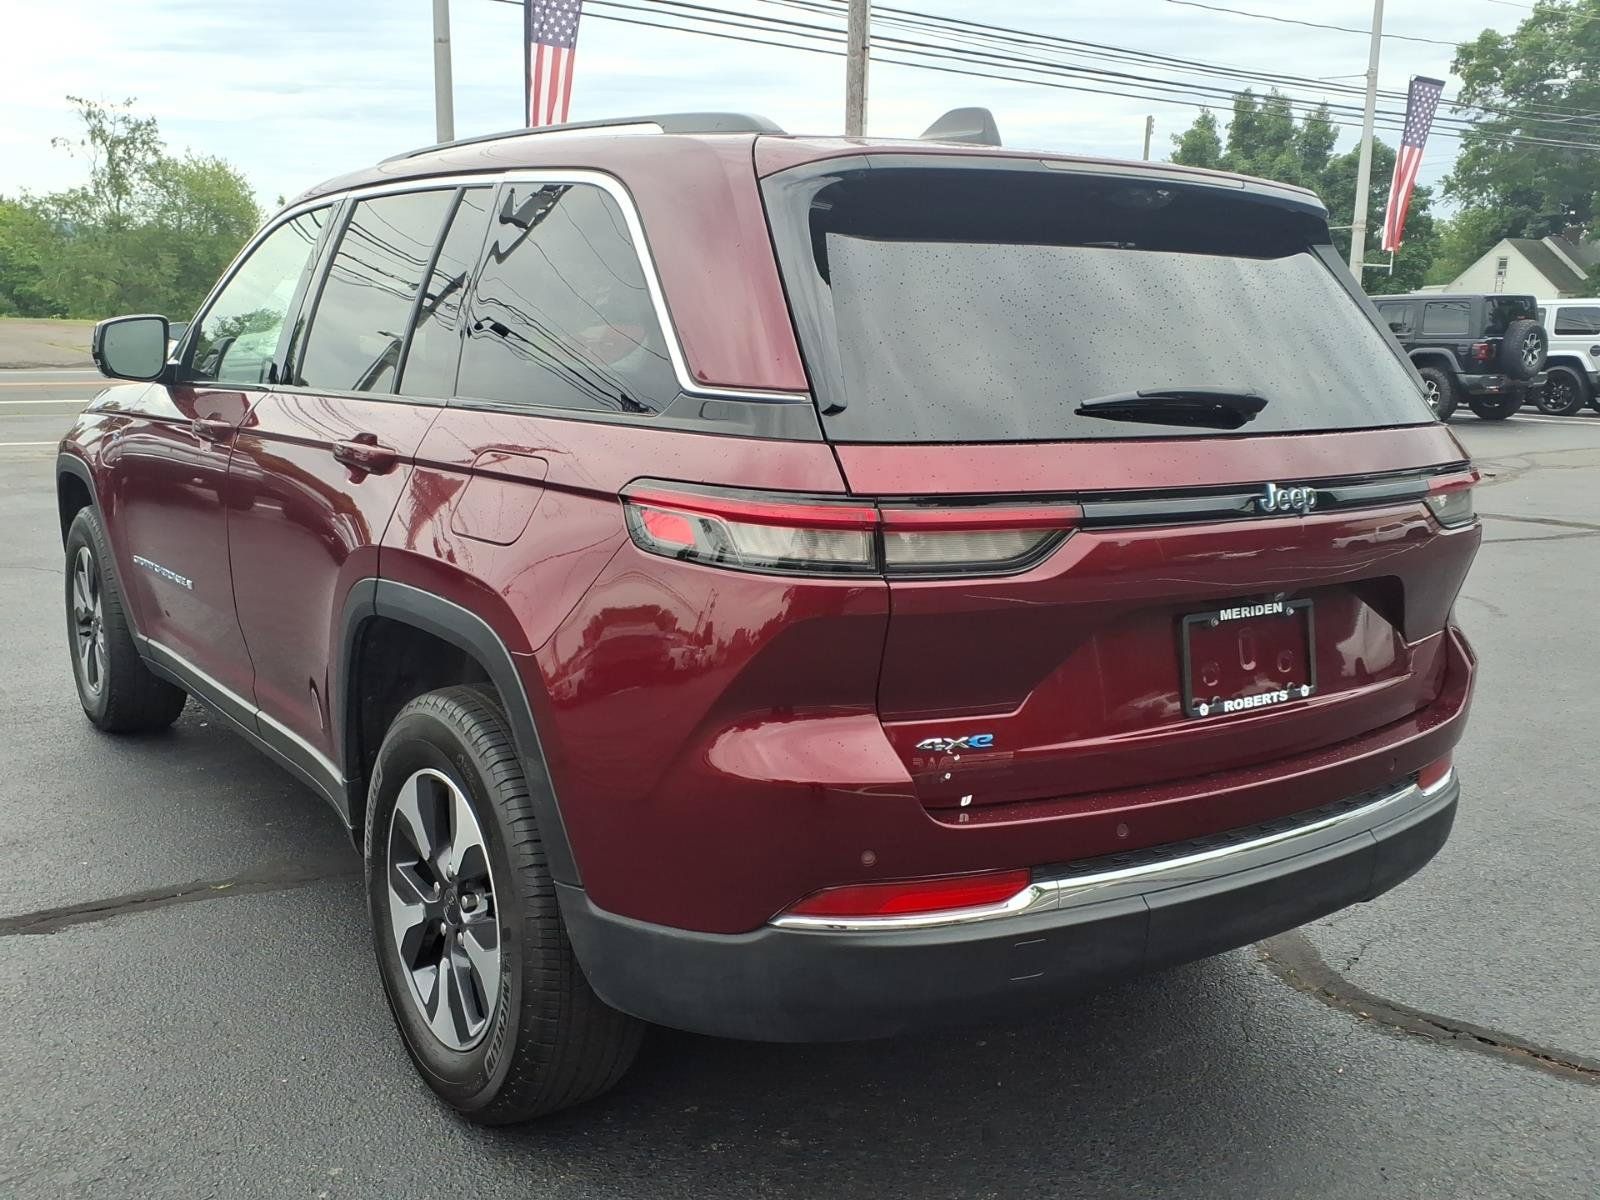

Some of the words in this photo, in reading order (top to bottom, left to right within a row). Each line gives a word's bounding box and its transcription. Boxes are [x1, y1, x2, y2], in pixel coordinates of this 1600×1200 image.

[1258, 482, 1317, 514] Jeep
[1220, 602, 1283, 621] MERIDEN
[1224, 690, 1288, 712] ROBERTS
[485, 978, 510, 1074] MICHELIN
